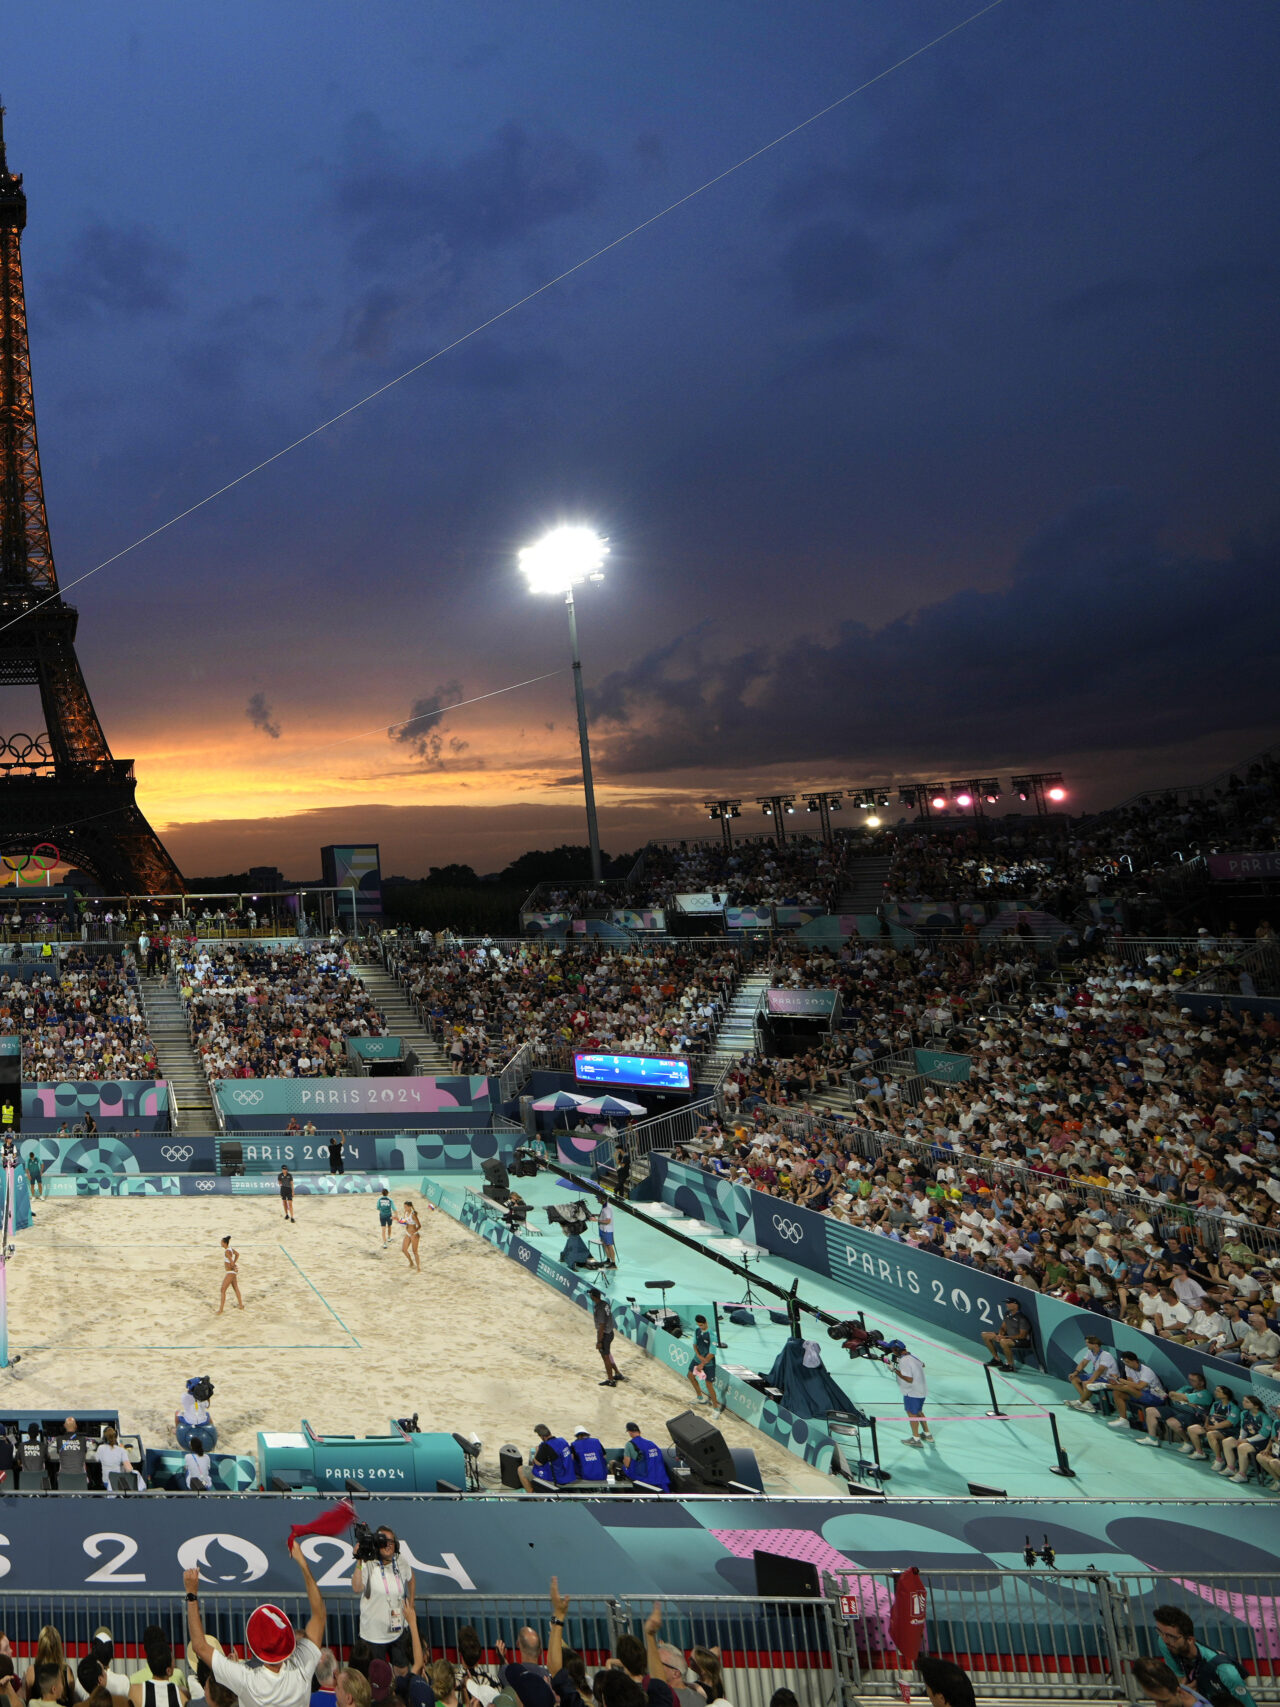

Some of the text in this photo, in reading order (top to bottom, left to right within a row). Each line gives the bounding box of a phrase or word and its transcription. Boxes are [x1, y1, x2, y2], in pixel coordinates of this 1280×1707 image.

[301, 1088, 421, 1104] PARIS 2024
[325, 1468, 405, 1479] PARIS 2024
